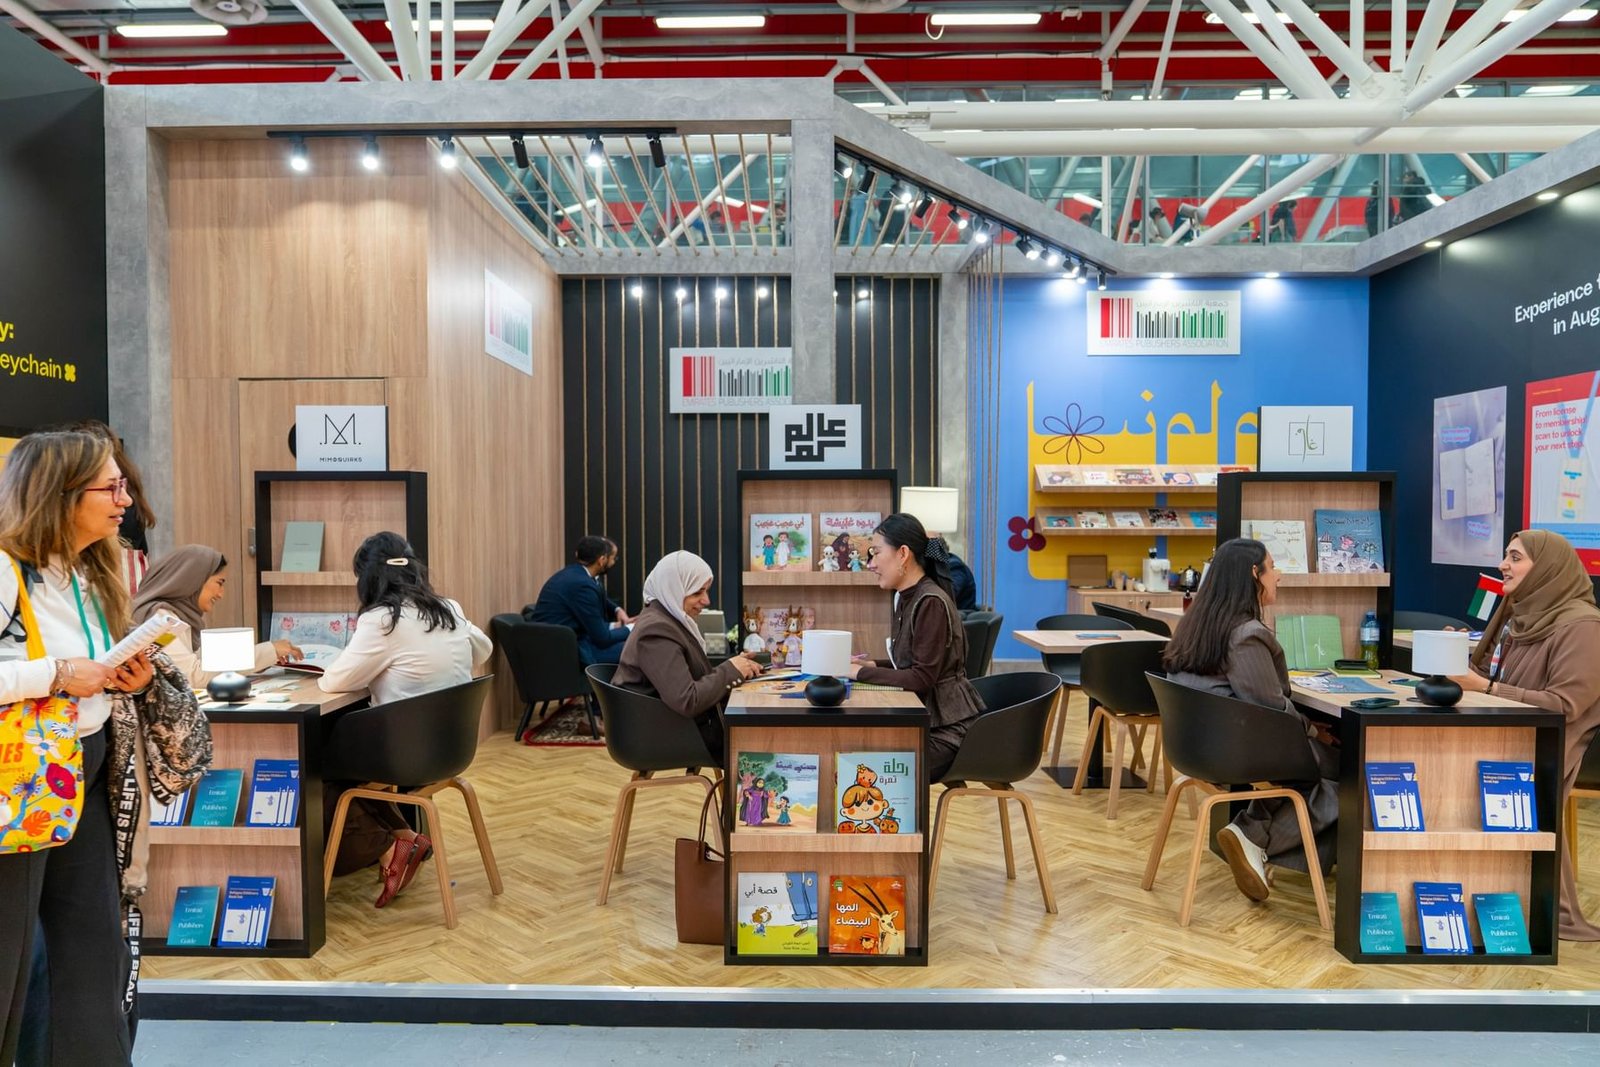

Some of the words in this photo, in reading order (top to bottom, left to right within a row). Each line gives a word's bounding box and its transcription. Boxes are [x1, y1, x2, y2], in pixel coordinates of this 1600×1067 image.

[1514, 282, 1593, 323] Experience
[1553, 318, 1566, 335] in
[0, 353, 62, 379] eychain
[1535, 410, 1552, 418] From
[1552, 431, 1559, 439] to
[1550, 441, 1566, 449] next
[119, 778, 136, 810] LIFE
[117, 813, 131, 827] IS
[835, 903, 859, 914] المها
[128, 904, 141, 936] LIFE
[835, 917, 871, 928] البيضاء
[130, 941, 140, 955] IS
[126, 959, 140, 1002] BEAU
